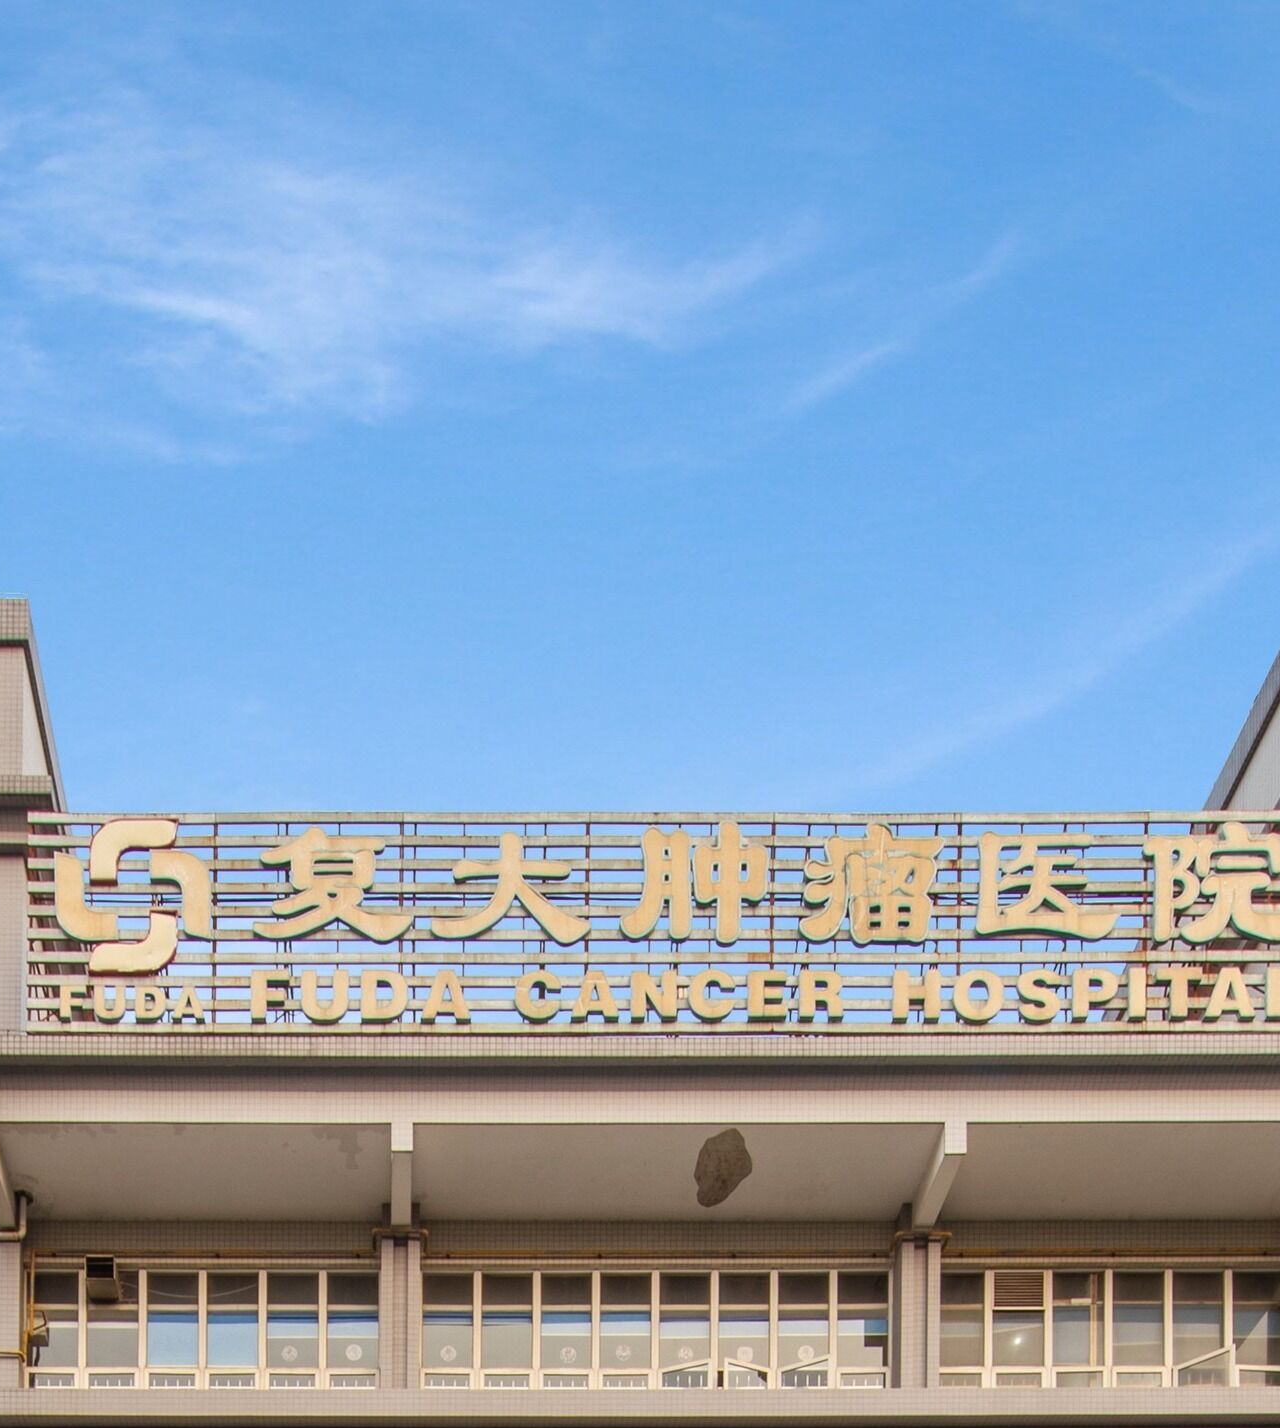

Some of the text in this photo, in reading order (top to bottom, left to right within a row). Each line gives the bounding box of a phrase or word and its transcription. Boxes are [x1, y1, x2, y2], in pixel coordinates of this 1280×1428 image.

[59, 984, 206, 1024] FUDA
[250, 968, 471, 1024] FUDA
[514, 968, 844, 1024] CANCER
